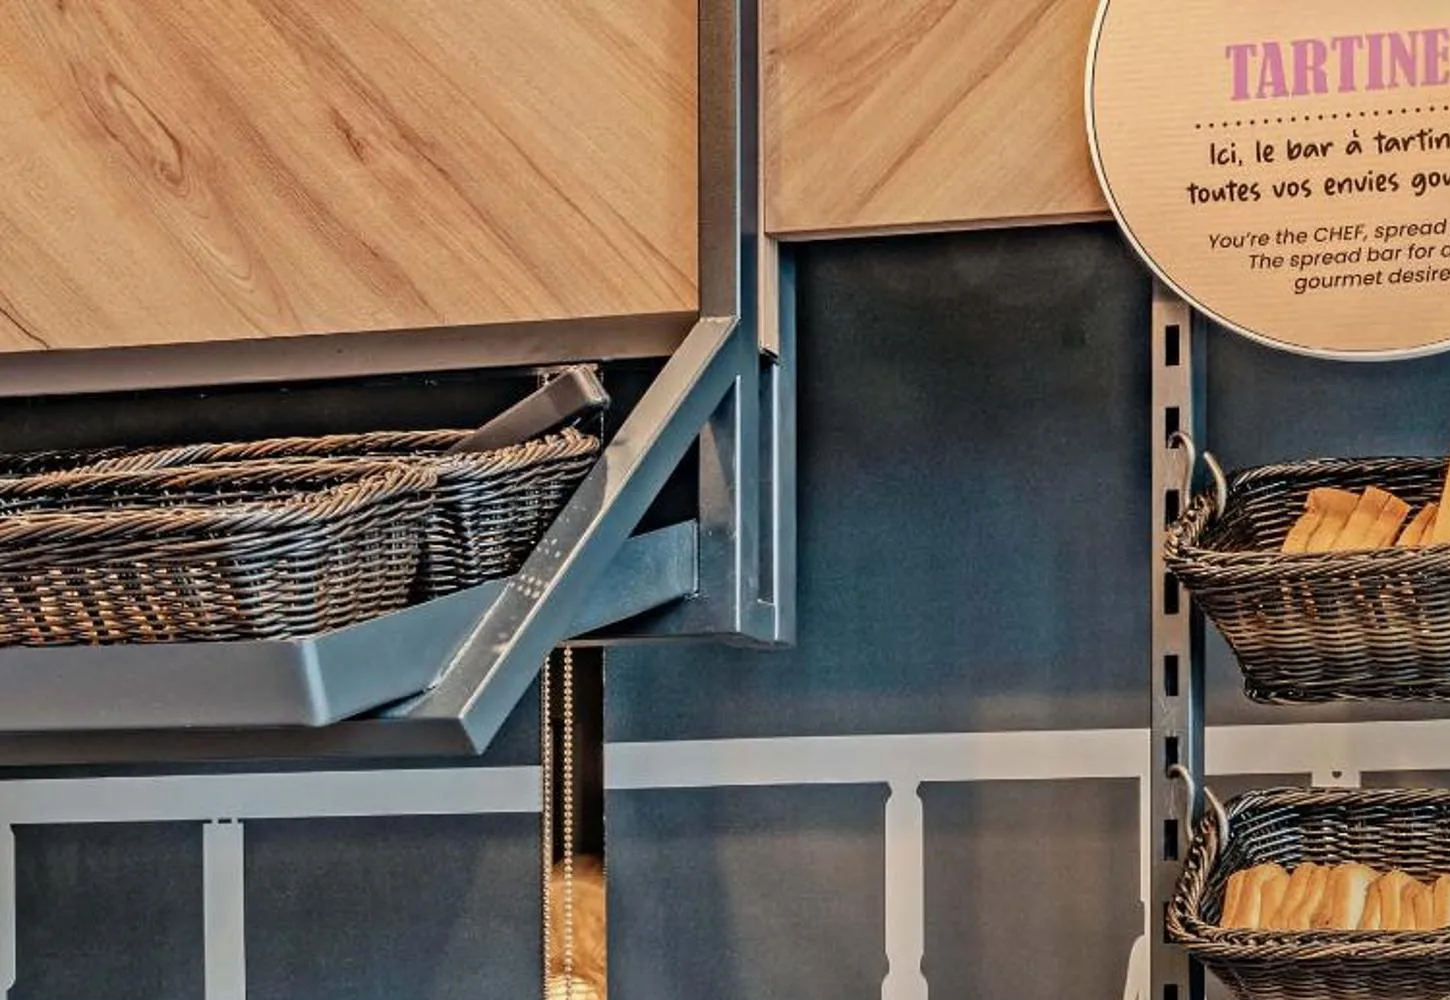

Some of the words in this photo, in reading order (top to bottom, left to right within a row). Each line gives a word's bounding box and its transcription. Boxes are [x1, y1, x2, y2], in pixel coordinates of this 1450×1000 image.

[1209, 142, 1242, 166] Ici,
[1255, 140, 1275, 163] le
[1287, 139, 1333, 161] bar
[1345, 129, 1362, 155] à
[1187, 179, 1261, 205] toutes
[1272, 178, 1312, 198] vos
[1324, 170, 1399, 196] envies
[1209, 231, 1270, 249] You're
[1275, 228, 1307, 245] the
[1313, 224, 1368, 242] CHEF,
[1374, 218, 1447, 243] spread
[1249, 253, 1284, 269] The
[1290, 247, 1362, 270] spread
[1367, 246, 1403, 263] bar
[1408, 243, 1436, 260] for
[1294, 270, 1383, 295] gourmet
